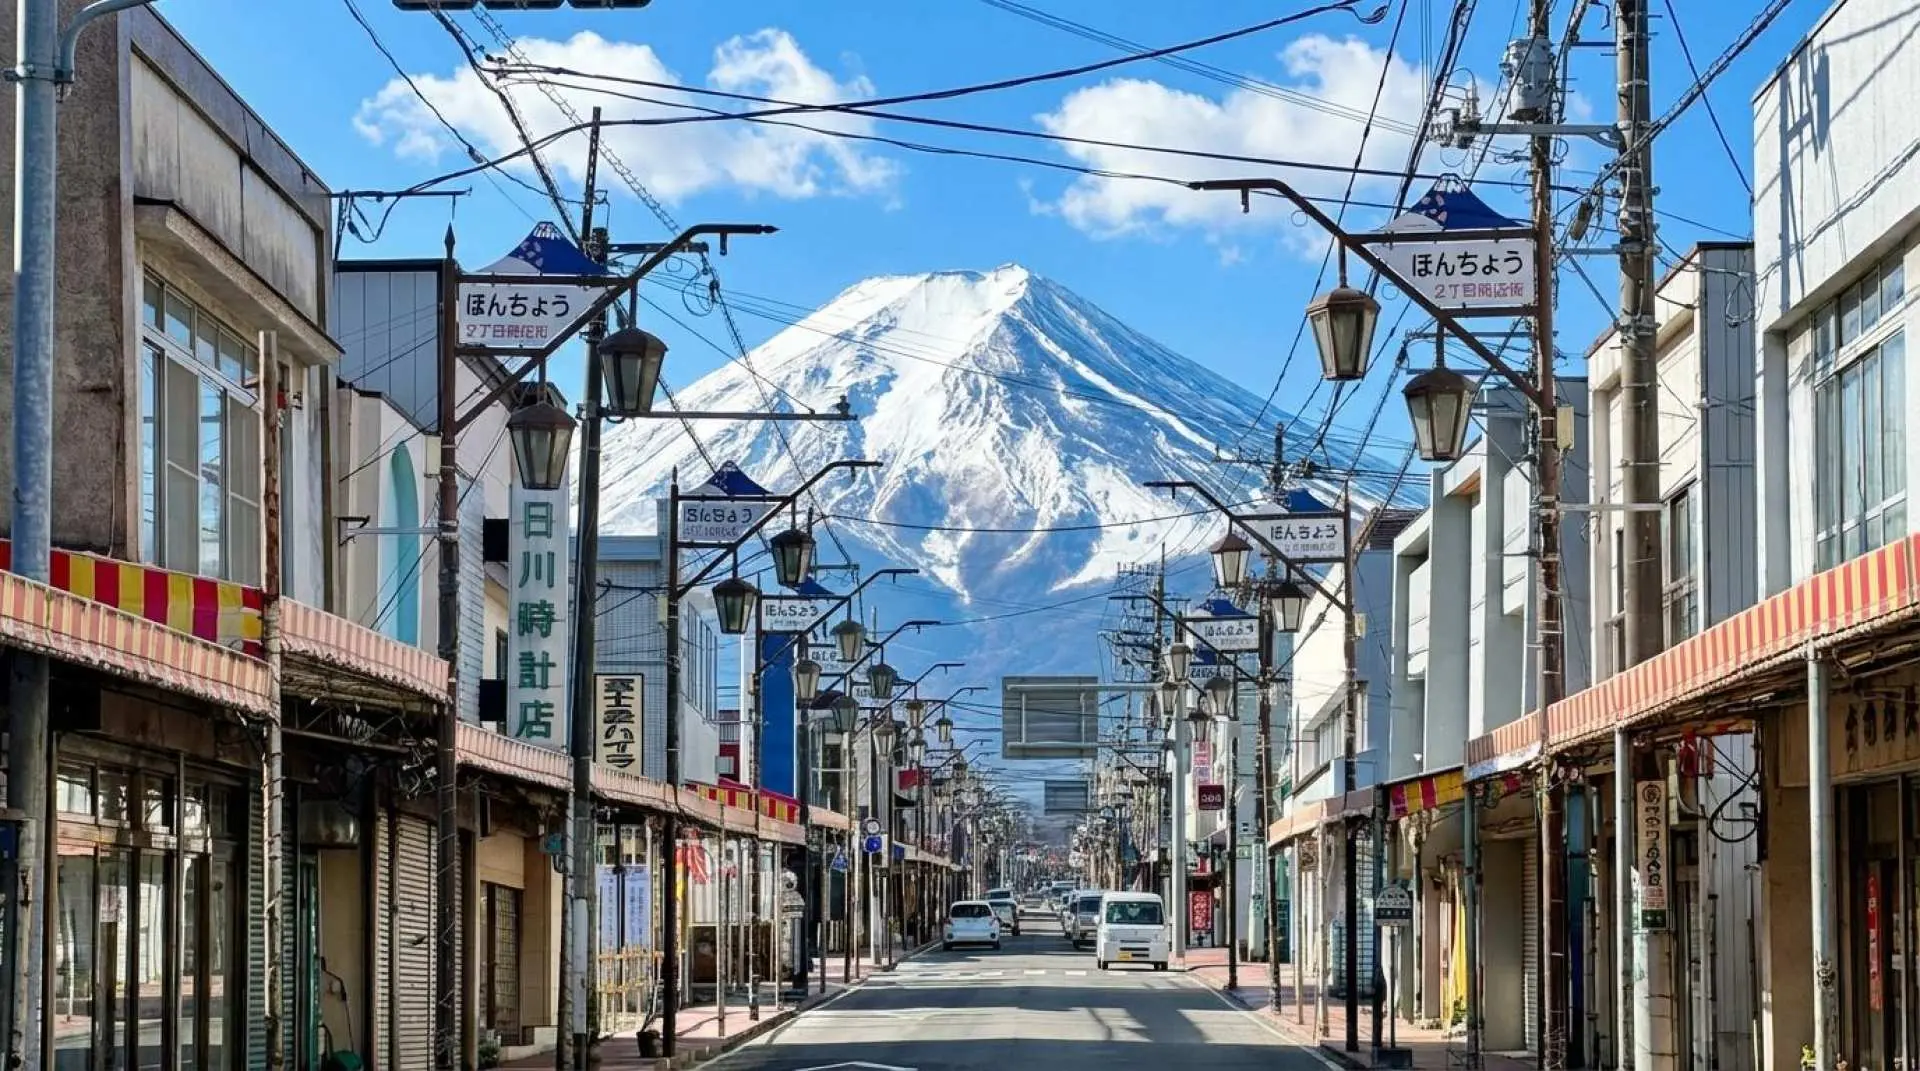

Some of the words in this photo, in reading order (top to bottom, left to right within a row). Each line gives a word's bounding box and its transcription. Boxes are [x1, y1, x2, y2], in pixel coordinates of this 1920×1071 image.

[1411, 250, 1524, 278] ほんちょう
[466, 292, 570, 318] ほんちょう
[515, 501, 557, 740] 日川時計店
